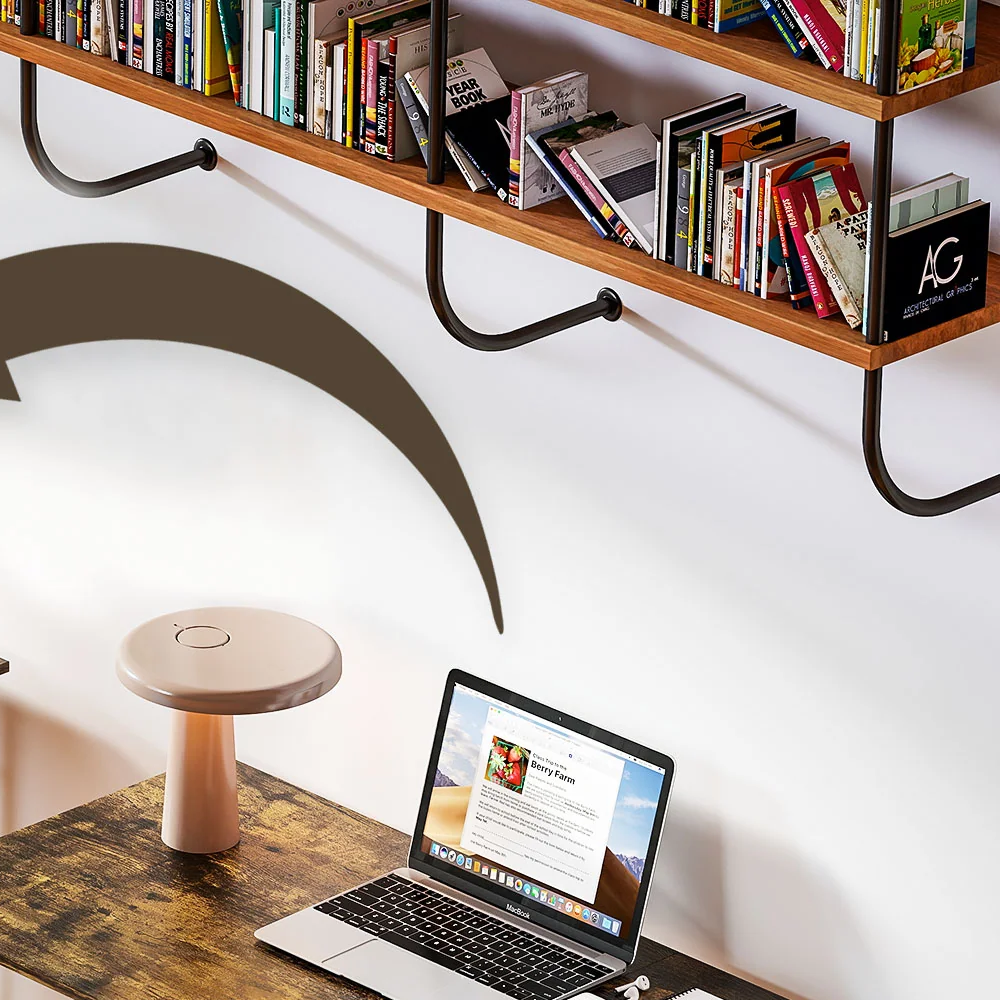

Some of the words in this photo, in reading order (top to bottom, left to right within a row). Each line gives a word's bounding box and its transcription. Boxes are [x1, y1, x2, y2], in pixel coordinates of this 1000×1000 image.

[166, 0, 174, 22] ECIPES
[446, 78, 480, 96] YEAR
[378, 102, 388, 114] THE
[450, 88, 488, 108] BOOK
[378, 114, 387, 137] SHACK
[836, 222, 844, 230] A
[918, 236, 963, 294] AG
[904, 294, 944, 314] ARCHITECTURAL
[531, 760, 554, 776] Berry
[554, 770, 576, 784] Farm
[506, 903, 530, 920] MacBook
